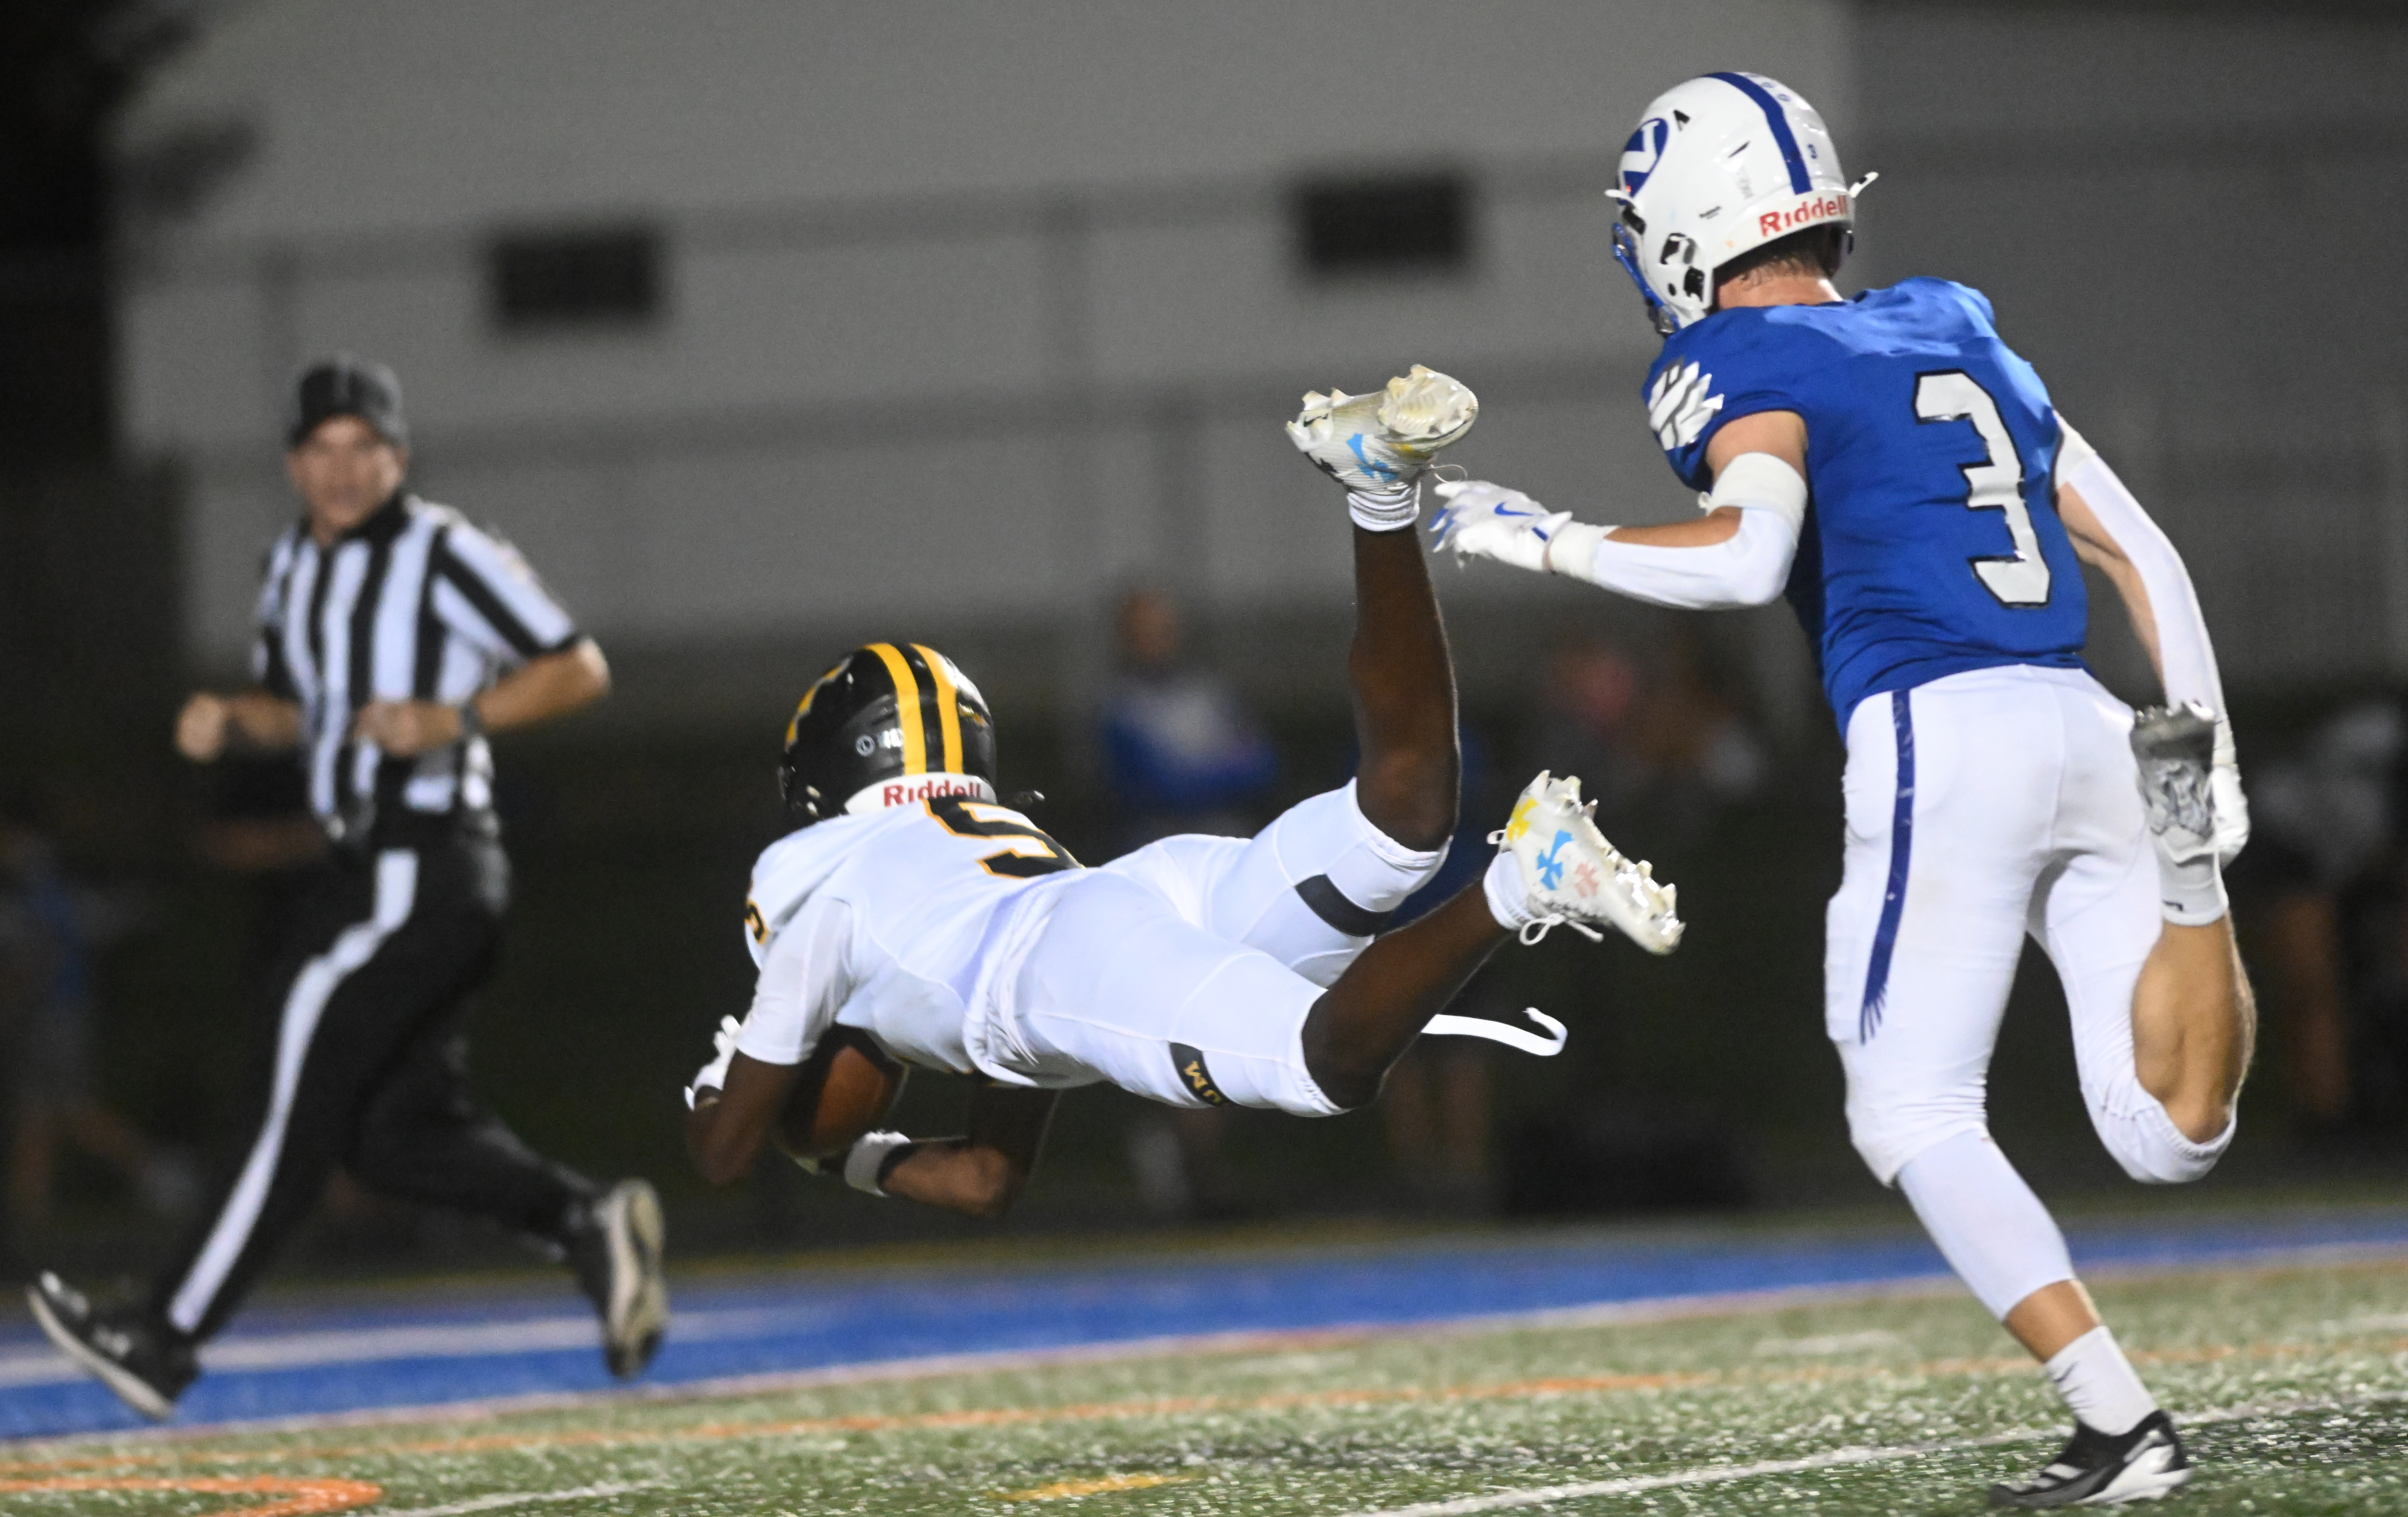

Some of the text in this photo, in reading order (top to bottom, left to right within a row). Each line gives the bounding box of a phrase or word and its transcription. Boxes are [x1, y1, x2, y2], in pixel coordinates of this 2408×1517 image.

[1760, 194, 1848, 237] Riddell
[1912, 369, 2051, 609] 3
[884, 779, 981, 807] Riddell
[920, 795, 1086, 879] 5
